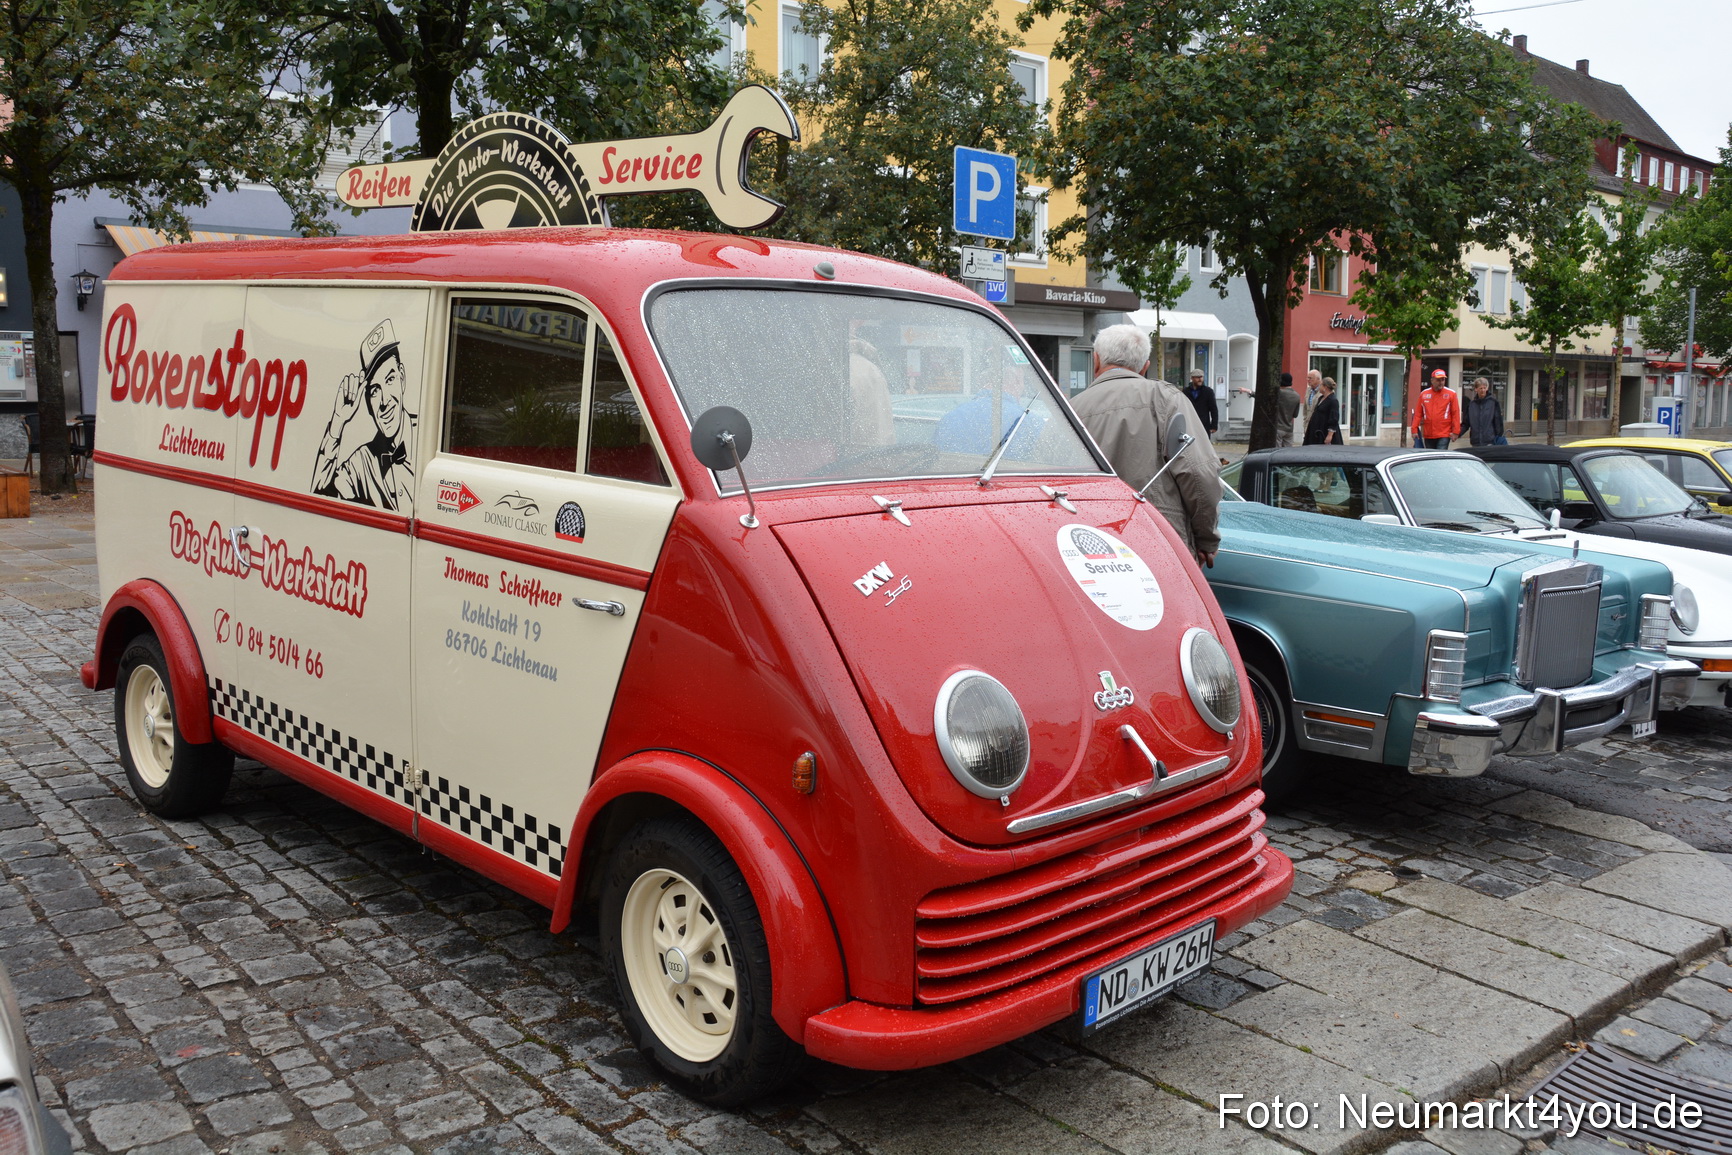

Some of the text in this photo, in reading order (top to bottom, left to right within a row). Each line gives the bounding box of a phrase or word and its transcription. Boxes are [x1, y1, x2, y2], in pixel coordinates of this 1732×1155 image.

[431, 138, 572, 218] Die Auto-Werkstatt
[598, 145, 703, 185] Service
[346, 166, 411, 207] Reifen
[969, 160, 1002, 223] P
[1045, 288, 1107, 304] Bavaria-Kino
[104, 303, 308, 471] Boxenstopp
[158, 423, 226, 461] Lichtenau
[439, 479, 461, 487] durch
[440, 490, 458, 501] 100
[437, 504, 459, 514] Bayern
[484, 511, 548, 537] DONAU CLASSIC
[169, 510, 201, 565] Die
[444, 556, 563, 608] Thomas Schöffner
[852, 561, 895, 597] DKW
[1084, 562, 1134, 574] Service
[461, 600, 542, 642] Kohlstatt 19
[236, 622, 324, 679] 0 84 50/4 66
[445, 629, 558, 682] 86706 Lichtenau
[1098, 927, 1213, 1014] ND KW 26H
[1088, 1005, 1095, 1017] D
